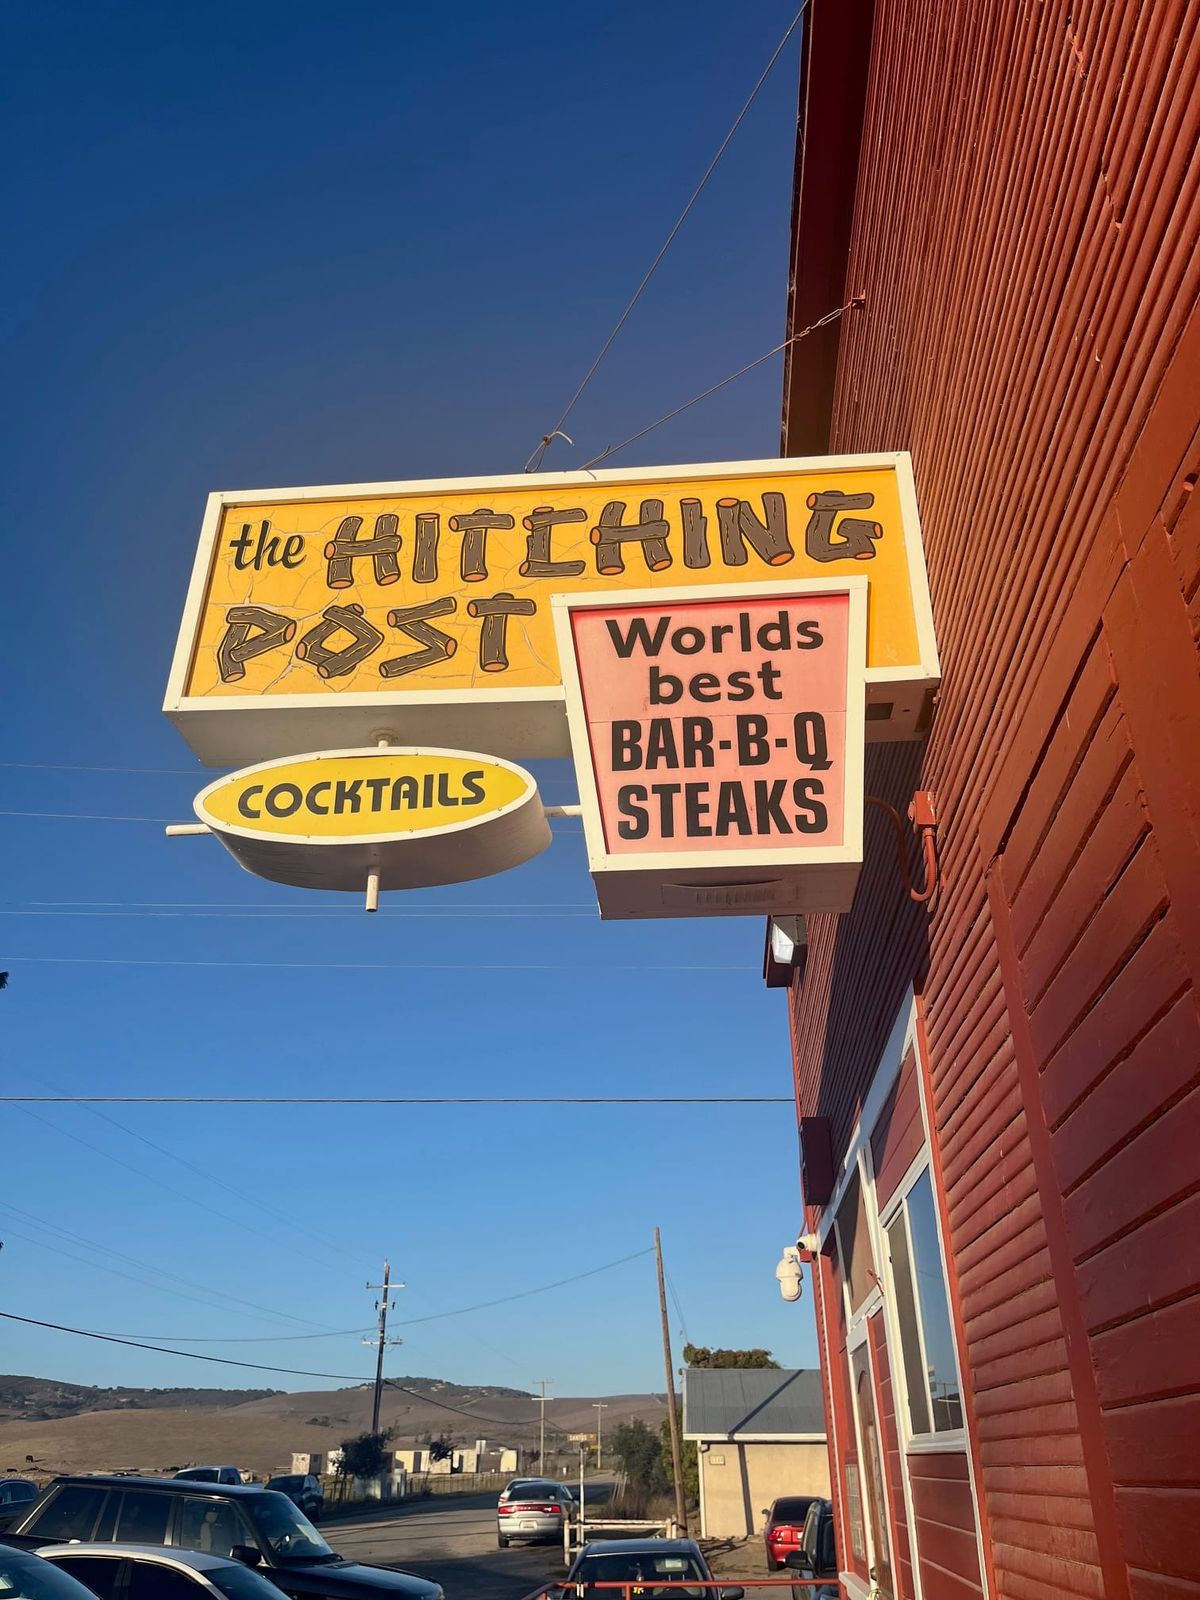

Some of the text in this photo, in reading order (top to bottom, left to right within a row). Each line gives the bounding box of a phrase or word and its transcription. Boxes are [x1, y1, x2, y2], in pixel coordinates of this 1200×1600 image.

[230, 490, 883, 589] the HITCHING
[217, 592, 537, 683] POST
[605, 610, 824, 659] Worlds
[649, 660, 783, 705] best
[611, 711, 834, 772] BAR-B-Q
[237, 770, 486, 819] COCKTAILS
[617, 778, 829, 841] STEAKS
